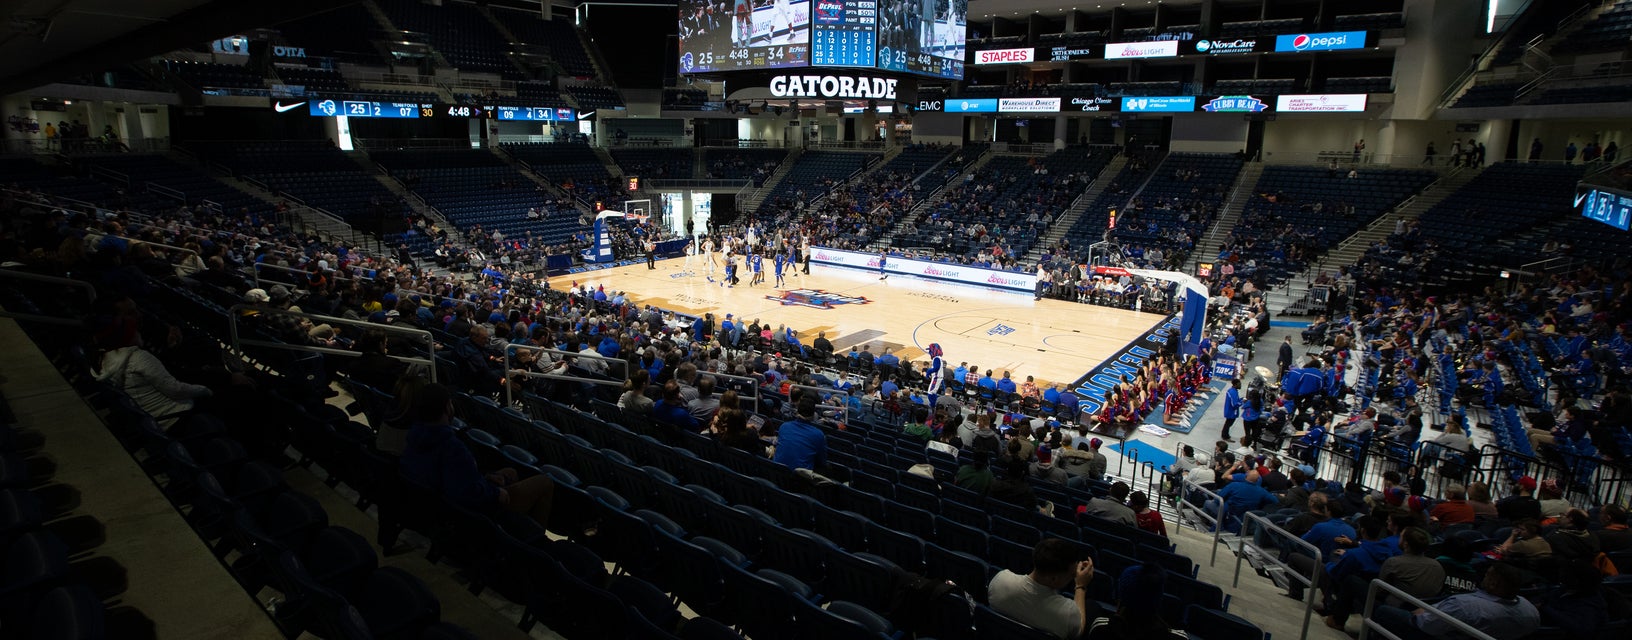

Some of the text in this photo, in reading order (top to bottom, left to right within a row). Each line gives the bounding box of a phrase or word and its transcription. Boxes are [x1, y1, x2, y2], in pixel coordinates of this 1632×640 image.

[1210, 40, 1256, 49] NovaCare
[1311, 35, 1347, 48] pepsi
[698, 48, 784, 64] 25 4:48 34
[1121, 46, 1144, 56] Coors
[895, 50, 907, 63] 25
[918, 54, 931, 65] 4:48
[942, 60, 951, 70] 34
[982, 51, 1028, 62] STAPLES
[770, 76, 898, 99] GATORADE
[350, 104, 365, 114] 25
[920, 101, 941, 110] EMC
[1213, 100, 1256, 109] CUBBY BEAR
[374, 107, 381, 116] 2
[400, 108, 411, 116] 07
[422, 108, 433, 117] 30
[448, 106, 470, 116] 4:48
[538, 110, 548, 118] 34
[1606, 204, 1613, 220] 2
[924, 265, 942, 276] Coors
[987, 273, 1008, 285] Coors
